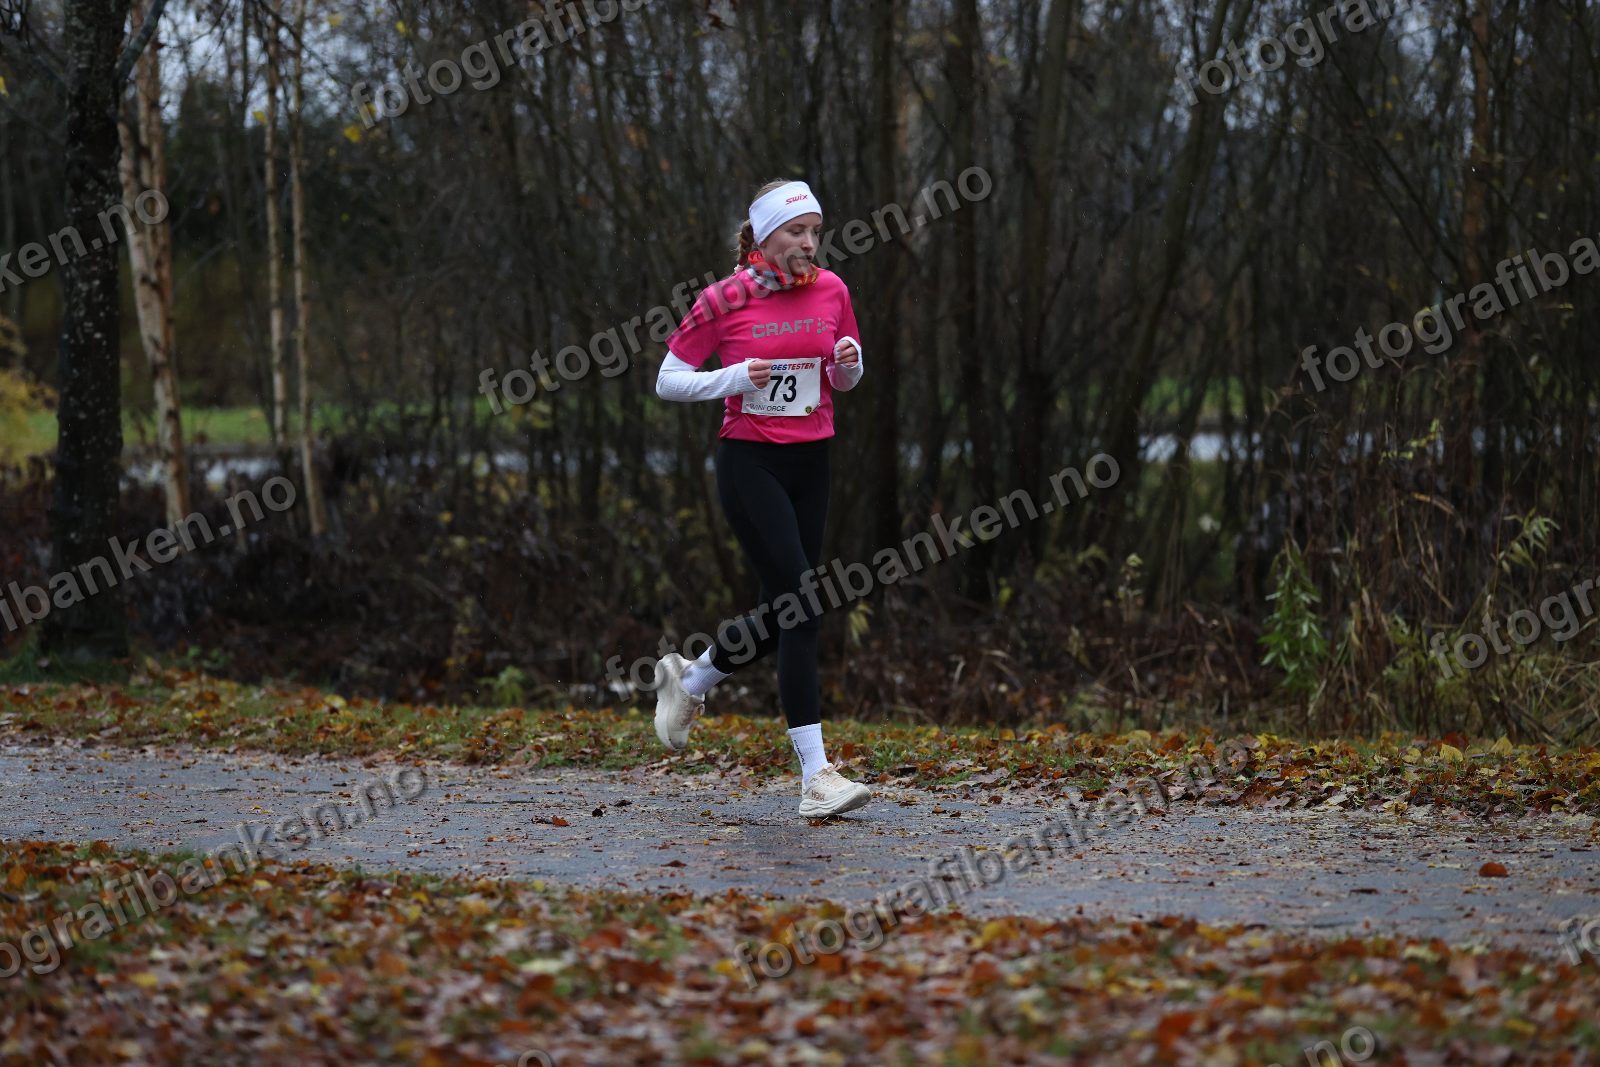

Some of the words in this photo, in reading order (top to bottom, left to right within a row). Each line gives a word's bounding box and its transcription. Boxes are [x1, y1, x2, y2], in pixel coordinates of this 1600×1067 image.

[752, 318, 814, 338] CRAFT
[771, 363, 815, 371] GESTESTEN
[769, 374, 797, 403] 73
